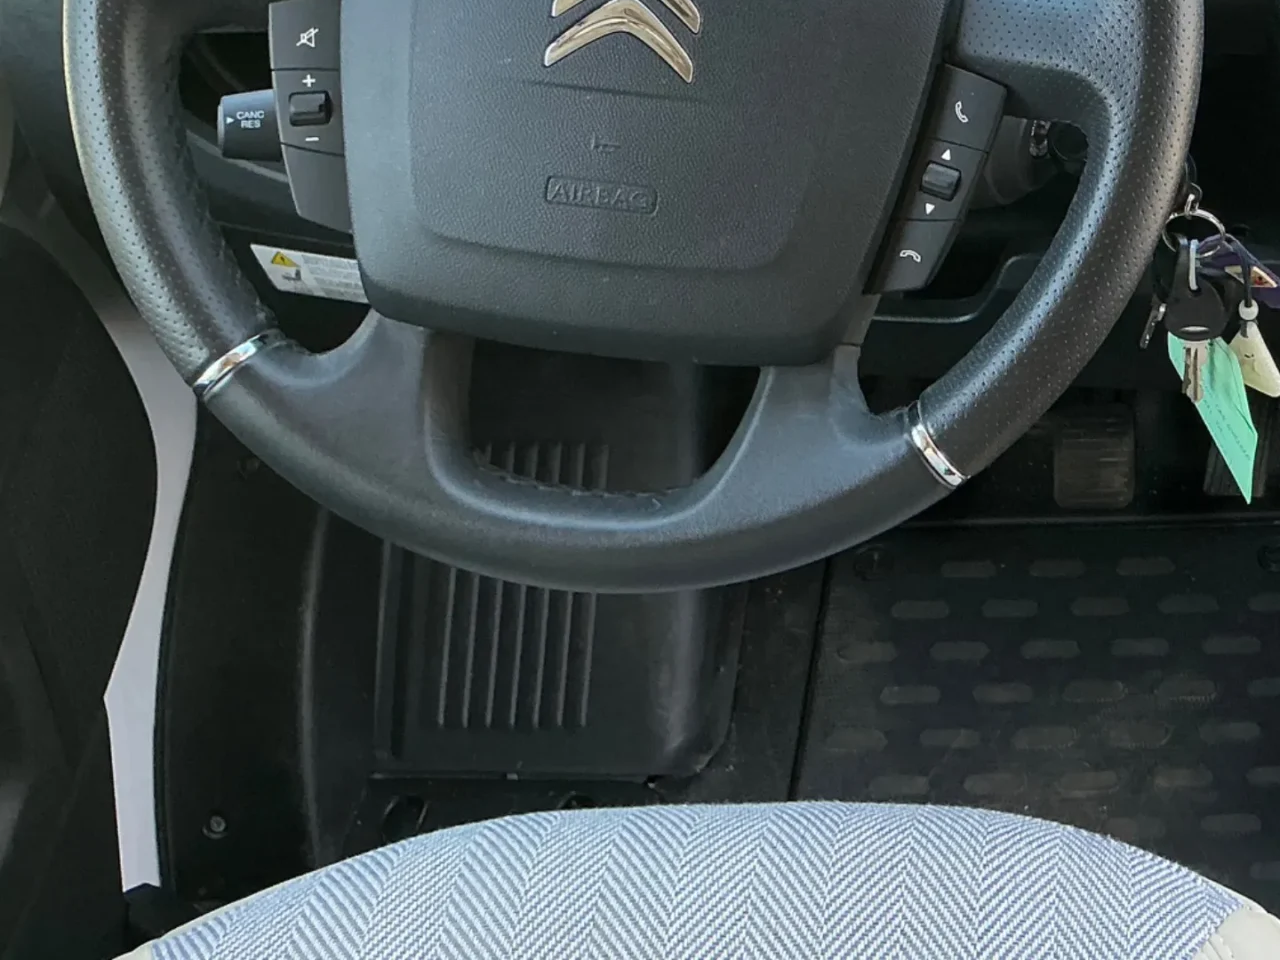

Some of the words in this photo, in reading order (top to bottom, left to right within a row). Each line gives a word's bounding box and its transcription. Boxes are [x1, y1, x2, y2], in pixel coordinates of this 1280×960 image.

[236, 110, 265, 120] CANC
[240, 119, 261, 129] RES
[550, 183, 649, 207] AIRBAG
